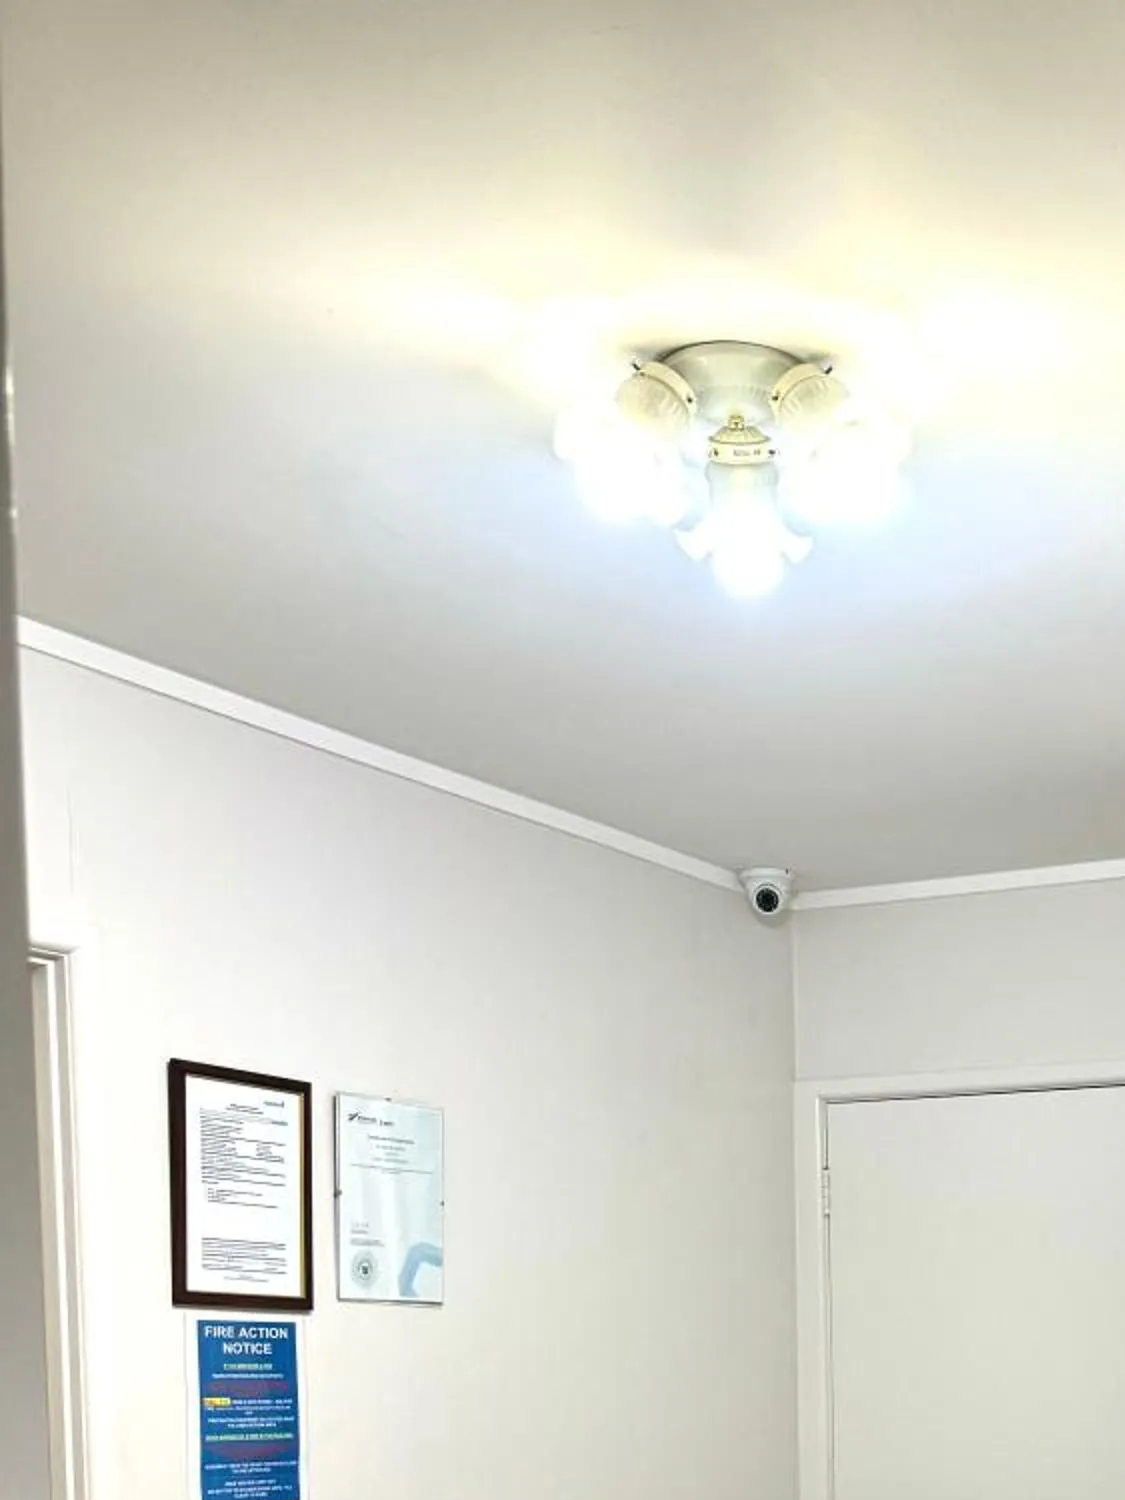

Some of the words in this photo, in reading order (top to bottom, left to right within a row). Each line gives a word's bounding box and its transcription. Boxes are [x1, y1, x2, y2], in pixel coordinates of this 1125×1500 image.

[204, 1325, 235, 1338] FIRE
[239, 1327, 288, 1339] ACTION
[223, 1342, 272, 1355] NOTICE
